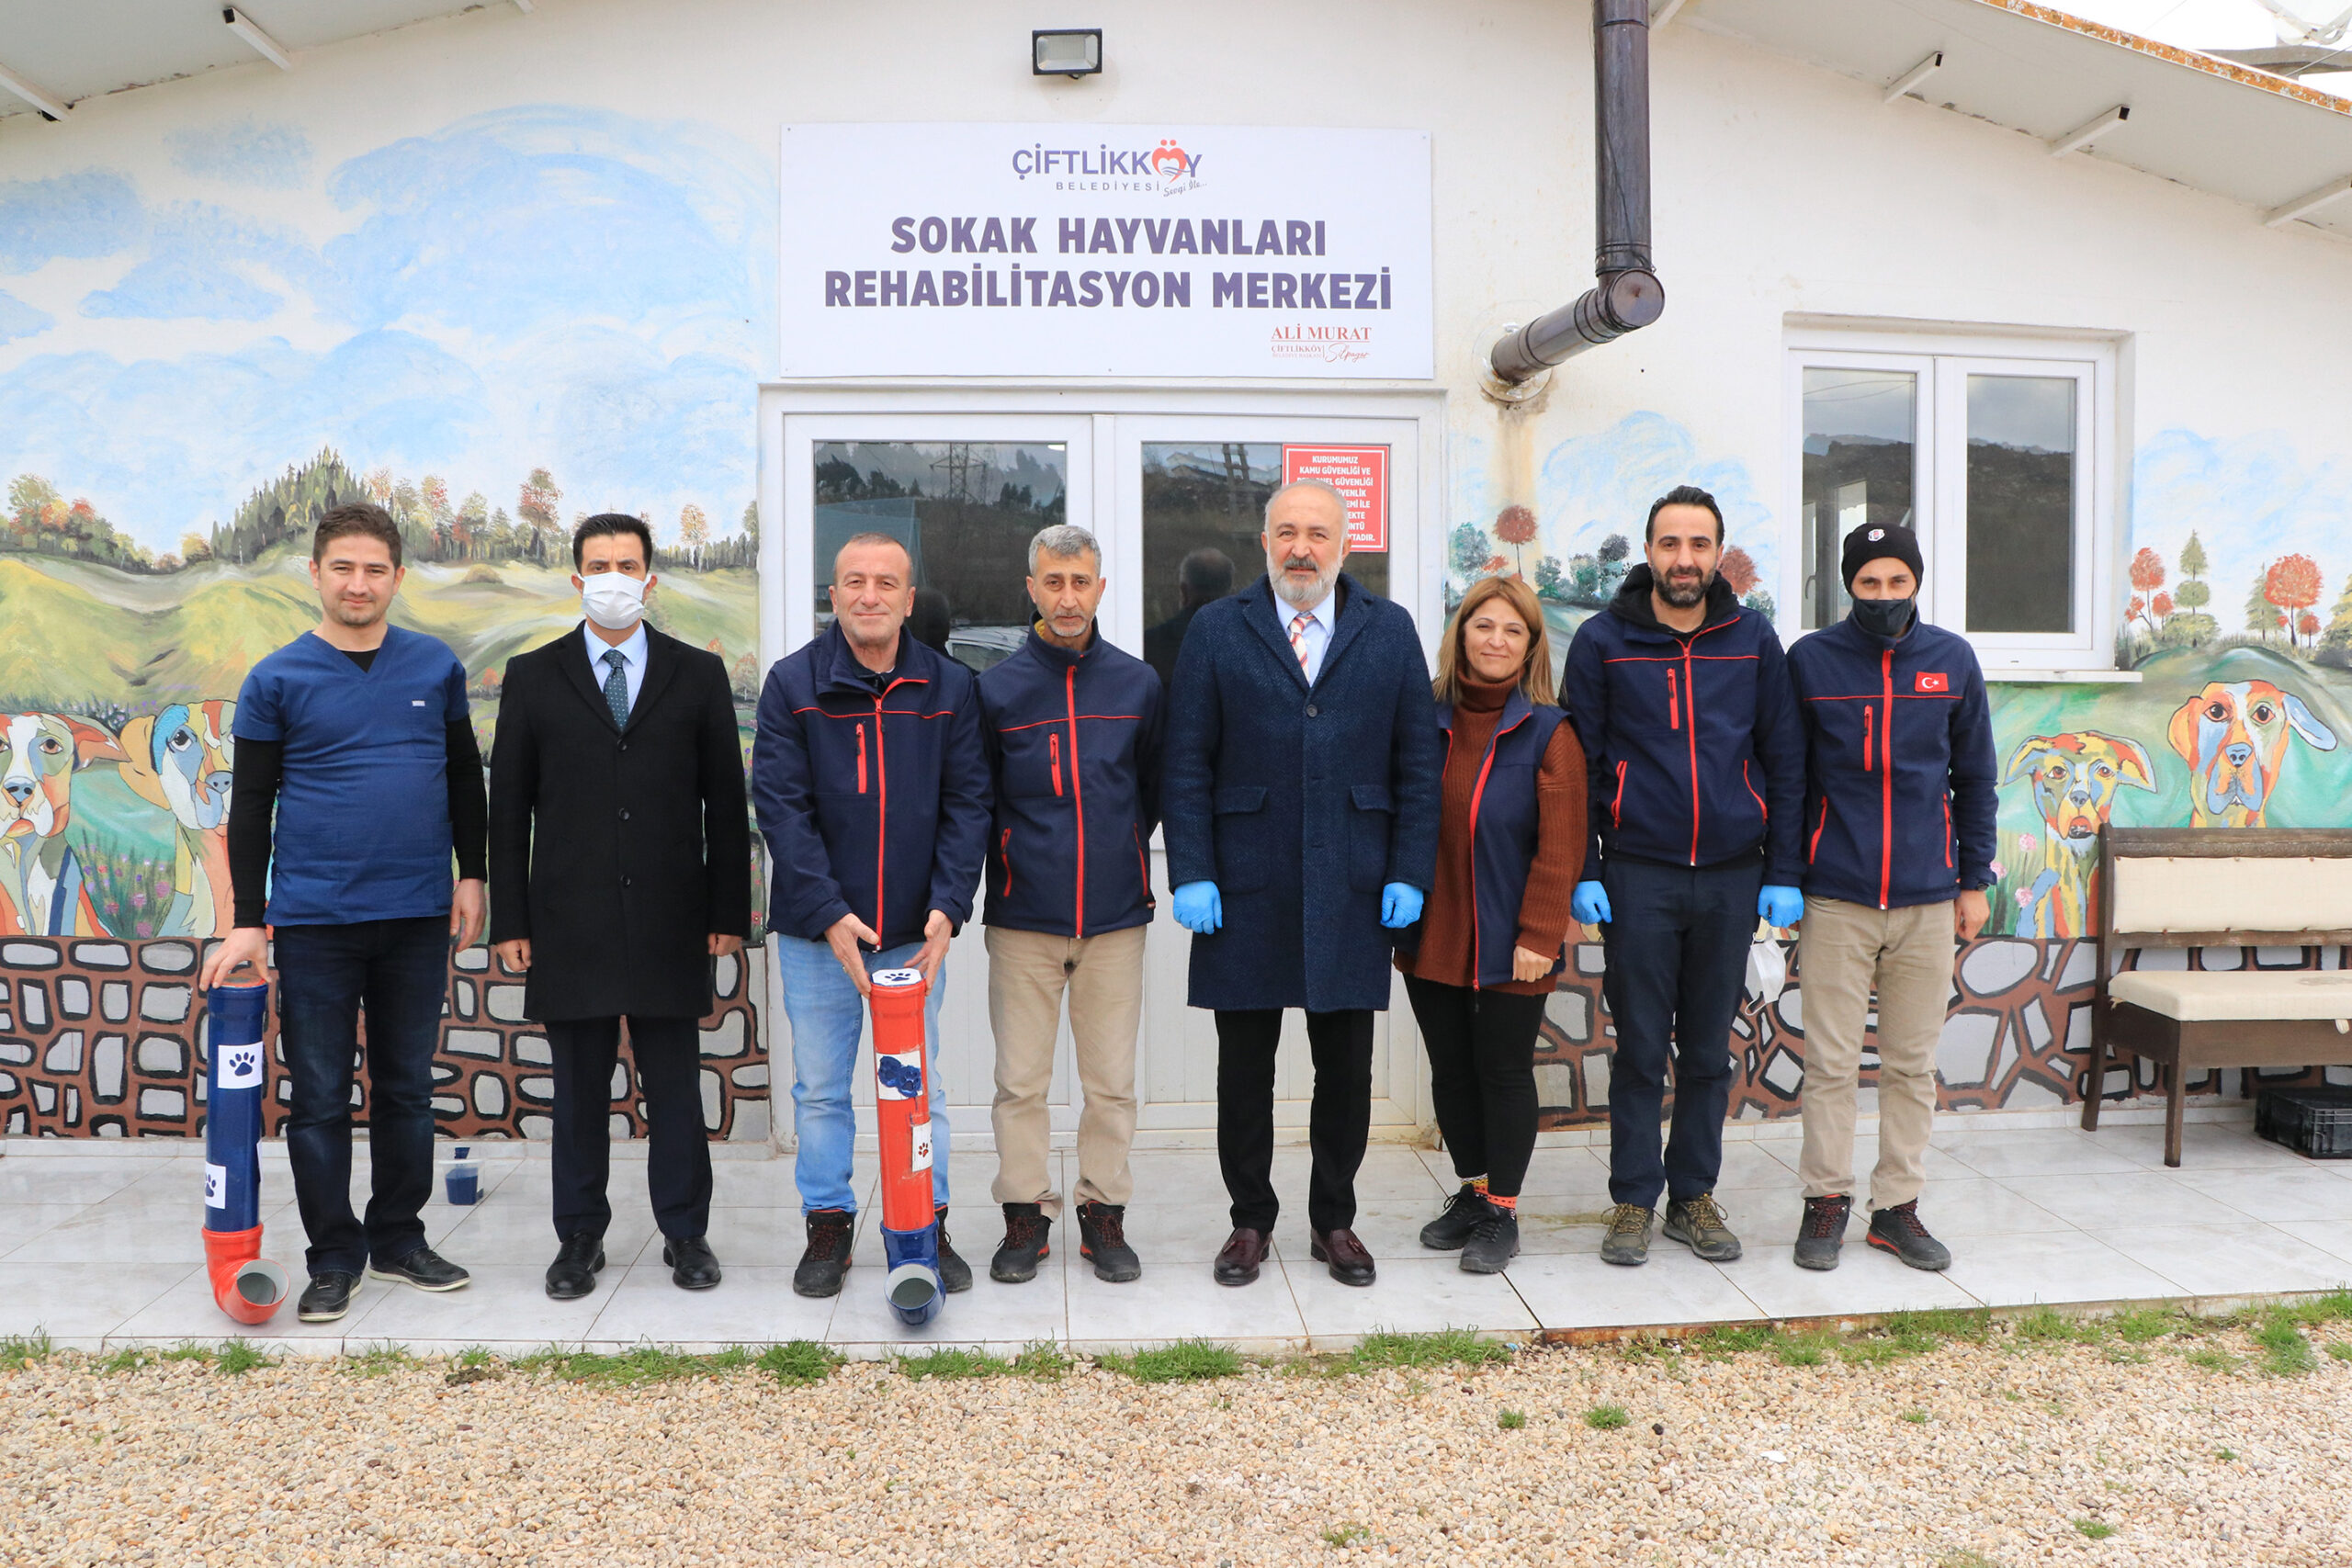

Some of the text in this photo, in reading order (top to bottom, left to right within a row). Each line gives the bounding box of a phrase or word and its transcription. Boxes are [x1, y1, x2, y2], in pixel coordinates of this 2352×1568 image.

[1056, 181, 1159, 192] BELEDİYESİ
[890, 216, 1326, 256] SOKAK HAYVANLARI
[825, 263, 1392, 310] REHABİLİTASYON MERKEZİ
[1272, 323, 1372, 340] ALİ MURAT
[1271, 344, 1322, 353] ÇİFTLİKKÖY
[1312, 456, 1359, 464] KURUMUMUZ
[1299, 465, 1371, 475] KAMU GÜVENLİĞİ VE
[1335, 477, 1374, 486] GÜVENLİĞİ
[1360, 500, 1370, 508] İLE
